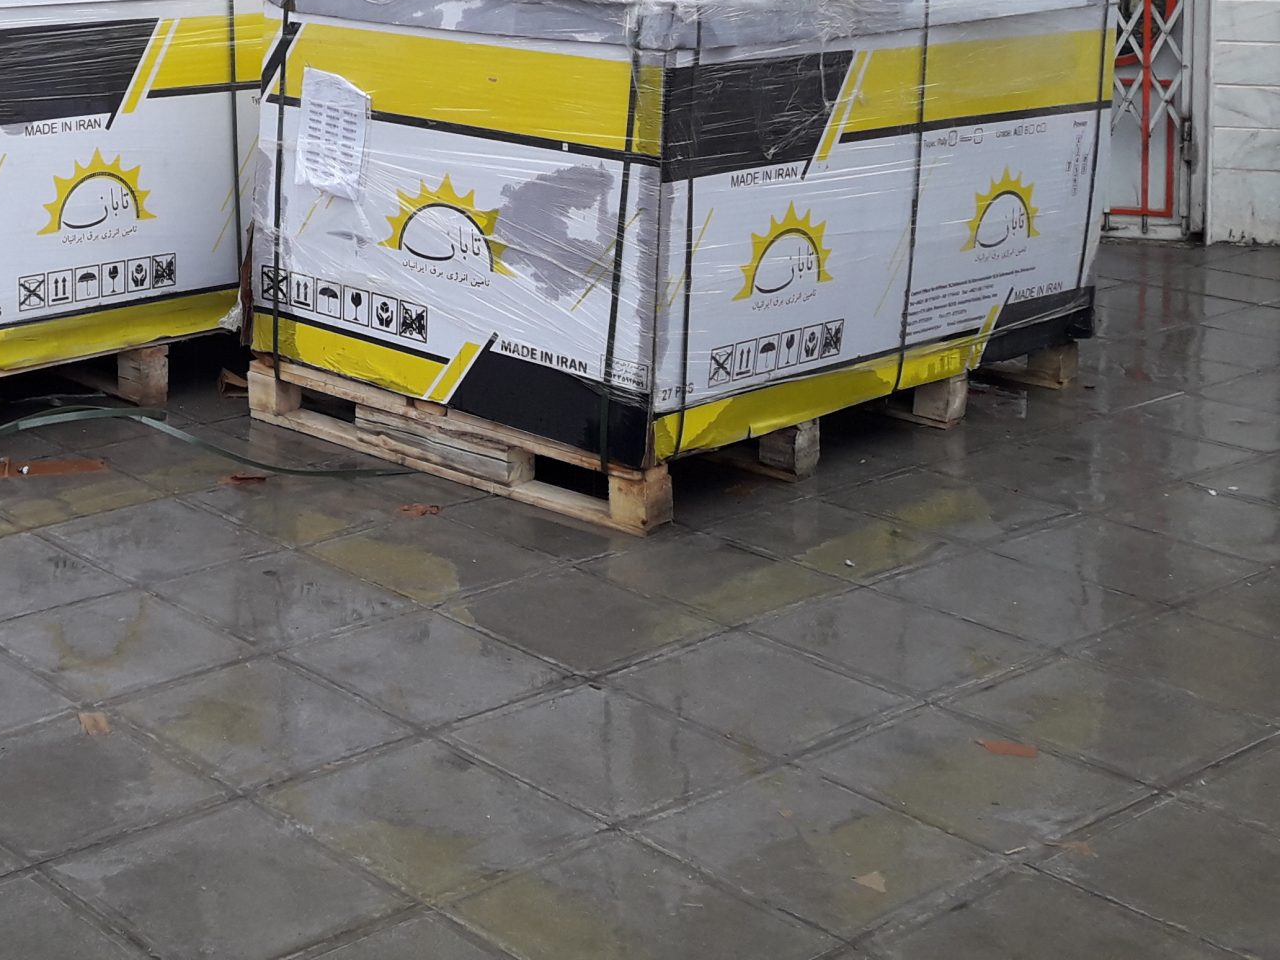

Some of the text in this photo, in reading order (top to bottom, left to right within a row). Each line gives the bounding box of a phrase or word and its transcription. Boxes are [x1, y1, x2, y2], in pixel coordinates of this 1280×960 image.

[24, 118, 101, 137] MADE IN IRAN
[730, 166, 798, 188] MADE IN IRAN
[62, 186, 129, 229] تابان
[976, 207, 1025, 249] تابان
[403, 226, 481, 261] تابان
[429, 265, 444, 278] برق
[754, 244, 814, 294] تابان
[1014, 281, 1063, 301] MADE IN IRAN
[500, 340, 587, 374] MADE IN IRAN
[661, 382, 695, 401] 27 PS
